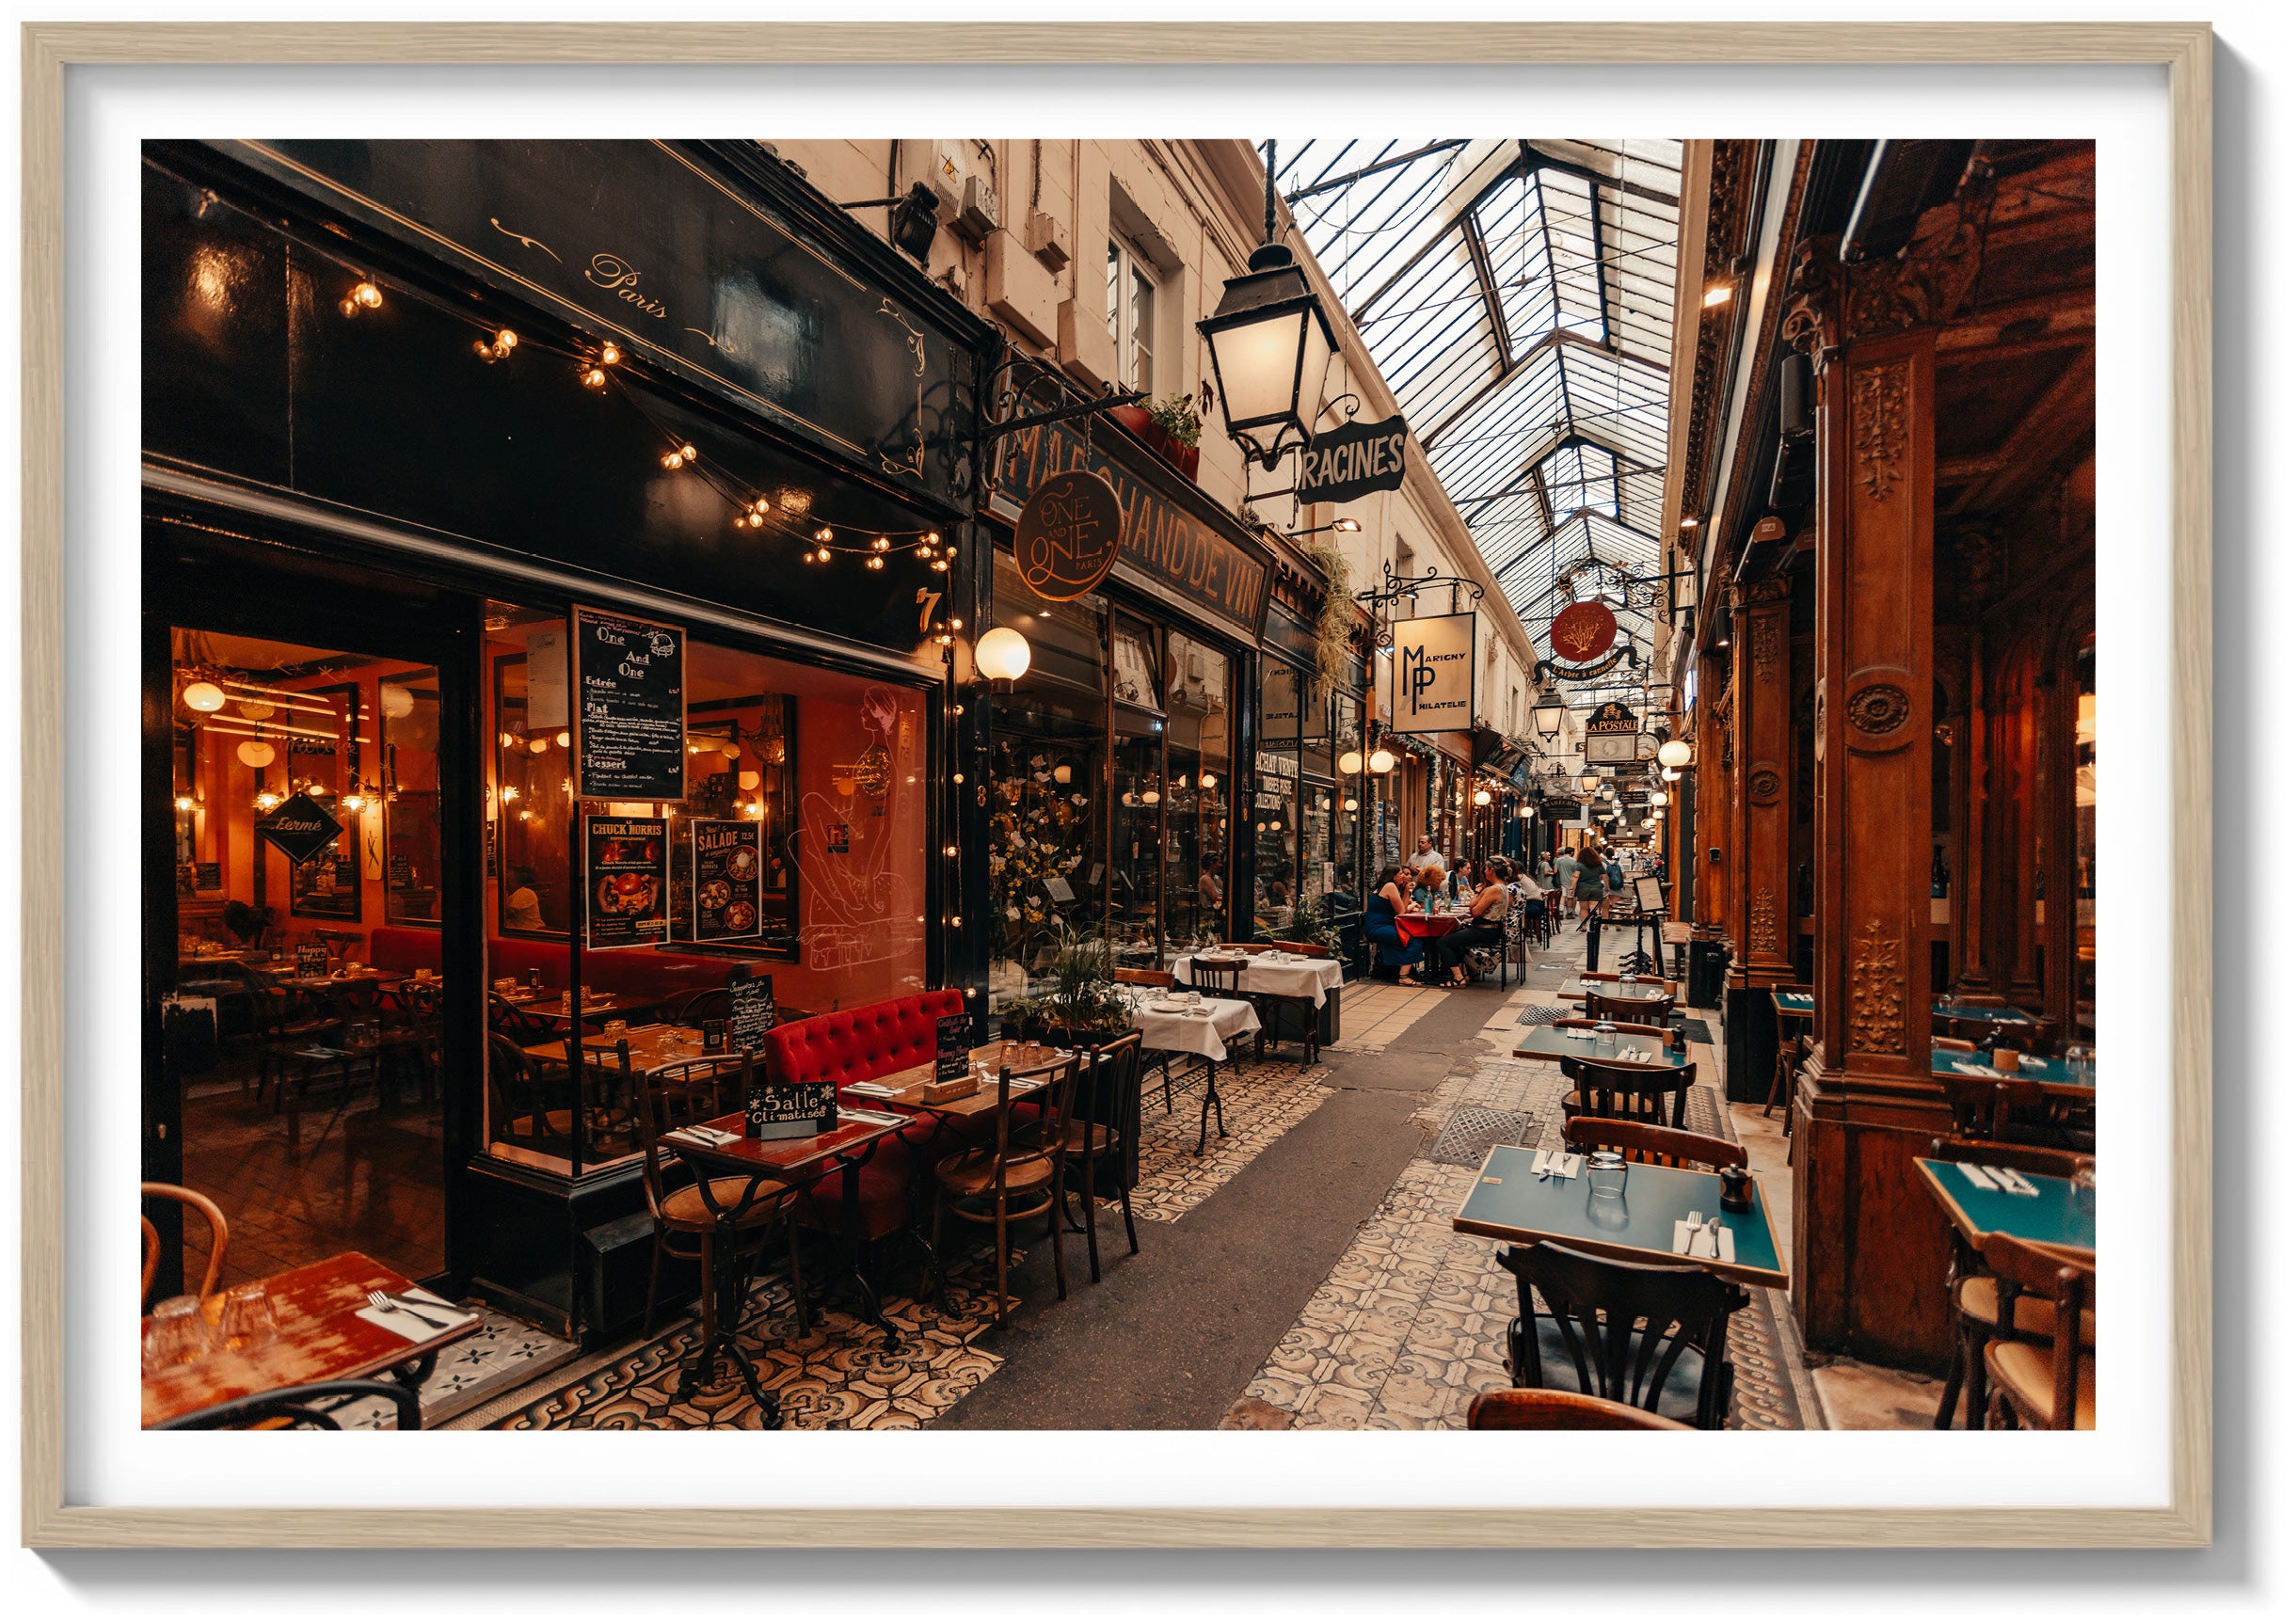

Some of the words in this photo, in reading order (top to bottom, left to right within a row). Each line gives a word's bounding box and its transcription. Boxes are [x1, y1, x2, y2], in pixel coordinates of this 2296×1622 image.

[584, 253, 667, 318] Paris
[1301, 434, 1404, 490] RACINES
[1039, 483, 1092, 527] ONE
[1009, 425, 1189, 580] MAHAND
[1188, 532, 1220, 599] DE
[1225, 554, 1260, 620] VIN
[1048, 528, 1067, 538] AND
[1028, 520, 1106, 580] ONE
[1076, 559, 1102, 570] PARIS
[916, 586, 942, 632] 7
[597, 627, 626, 644] One
[626, 650, 650, 664] And
[618, 662, 645, 677] One
[1553, 666, 1579, 678] L'Arbre
[1582, 670, 1587, 678] à
[1588, 658, 1618, 676] cannelle
[585, 676, 616, 688] Entrée
[587, 702, 609, 714] Plat
[1599, 720, 1638, 732] POSTALE
[587, 758, 628, 770] Dessert
[1255, 751, 1277, 774] ACHAT
[1278, 756, 1299, 779] VENTE
[976, 785, 987, 808] 8
[1242, 807, 1249, 822] 8
[275, 816, 322, 832] Fermé
[592, 823, 627, 835] CHUCK
[629, 824, 662, 835] NORRIS
[698, 831, 738, 851] SALADE
[763, 1091, 819, 1111] Salle
[752, 1107, 826, 1124] Climatisée
